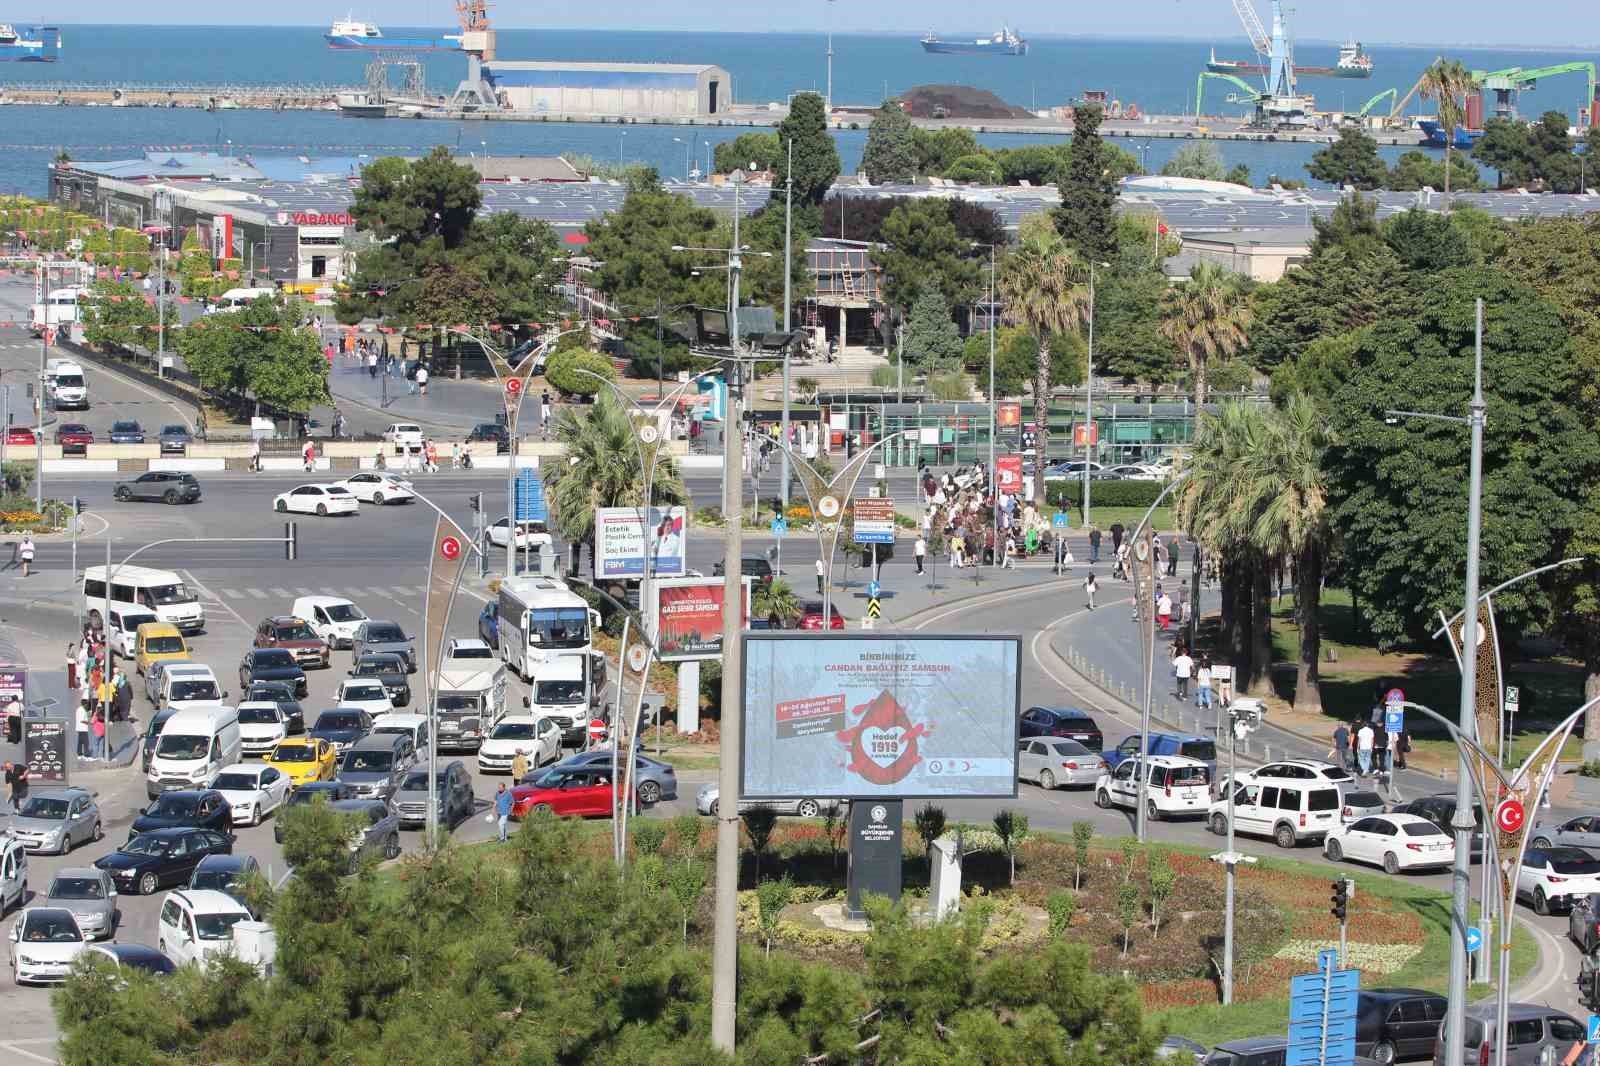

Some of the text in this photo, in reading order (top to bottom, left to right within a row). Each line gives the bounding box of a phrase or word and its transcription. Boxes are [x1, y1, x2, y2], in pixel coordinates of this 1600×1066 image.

[605, 525, 630, 533] Estetik
[605, 533, 626, 541] Plastik
[605, 546, 619, 554] Saç
[824, 664, 863, 672] CANDAN
[911, 664, 951, 672] SAMSUN
[871, 741, 899, 753] 1919
